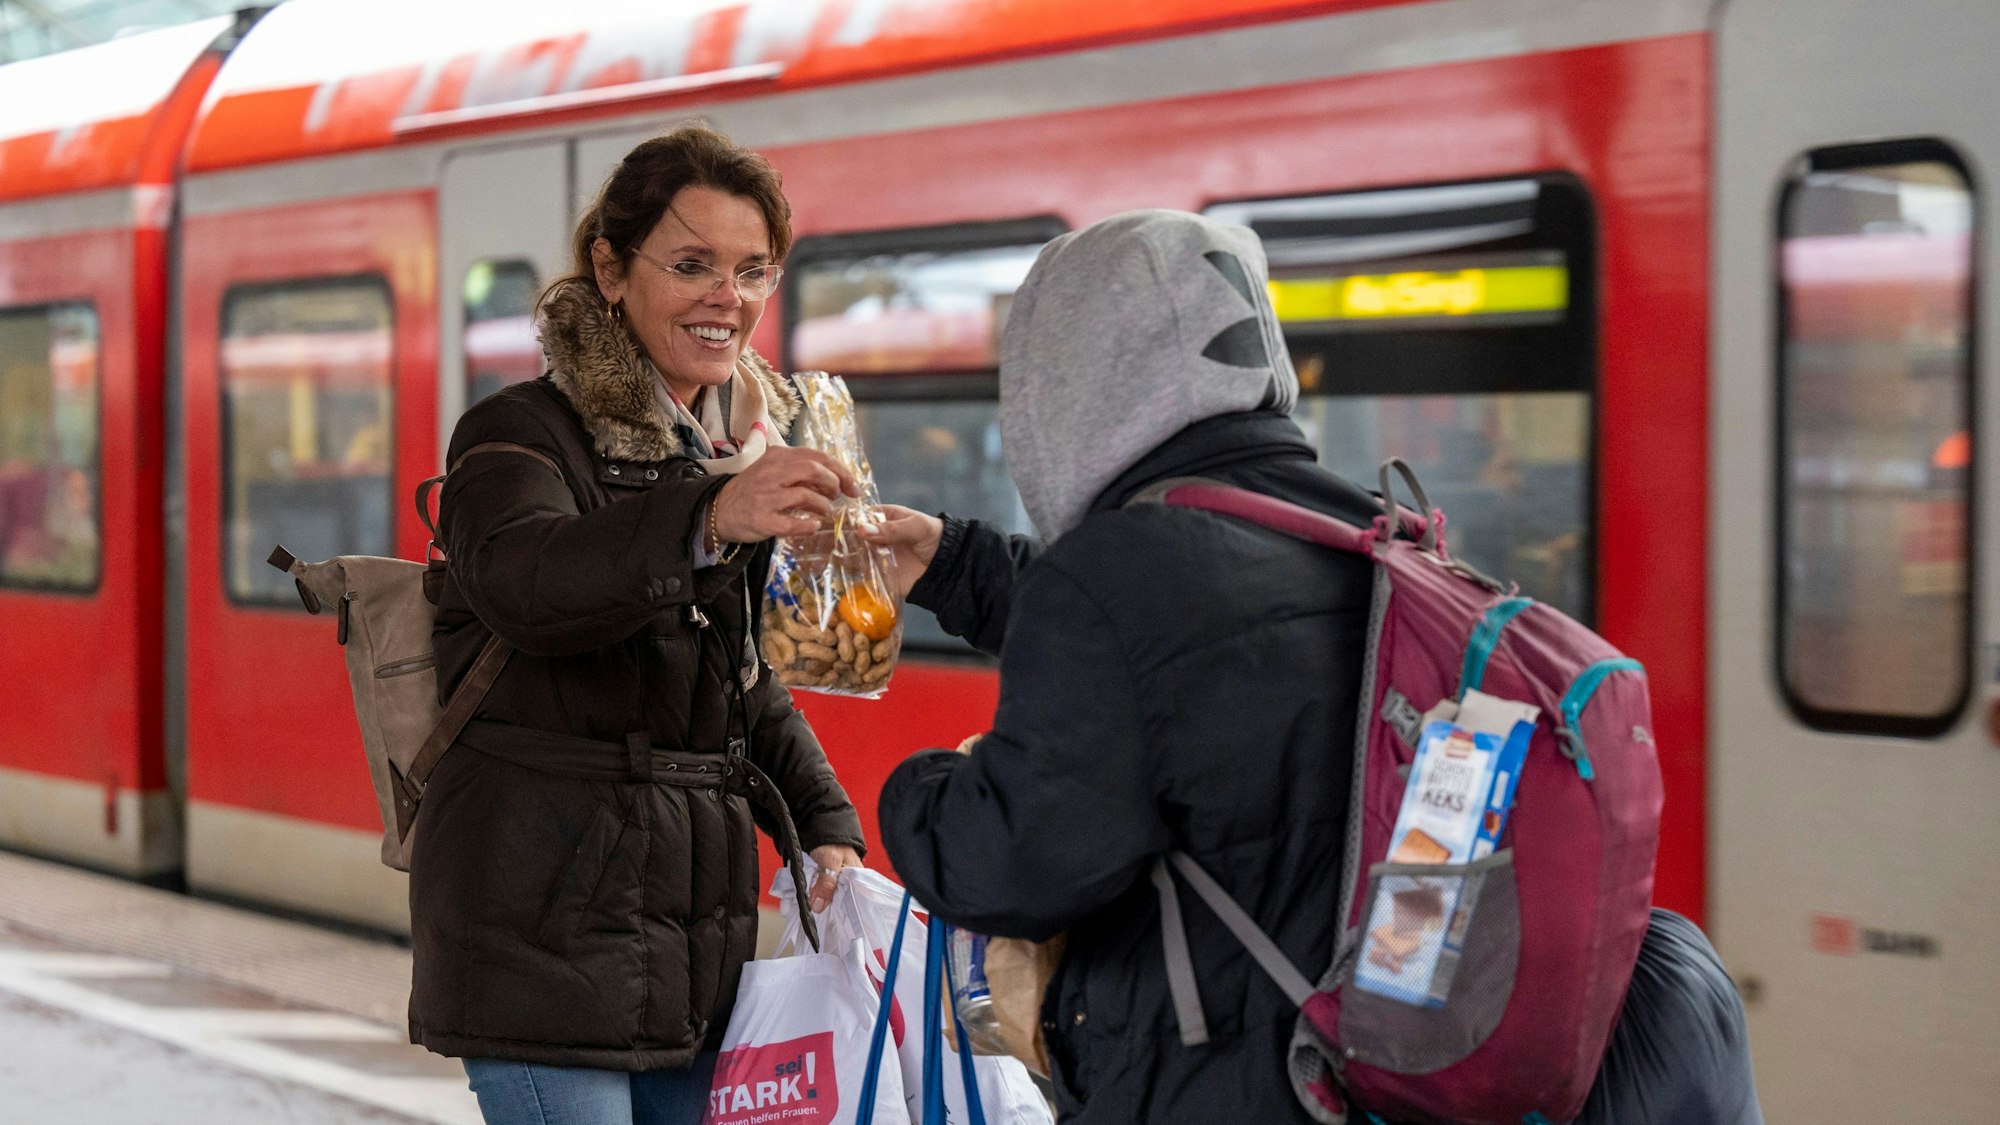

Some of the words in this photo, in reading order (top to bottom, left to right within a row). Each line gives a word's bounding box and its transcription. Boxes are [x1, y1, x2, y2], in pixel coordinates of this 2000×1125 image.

[1422, 789, 1465, 812] KEKS
[775, 1055, 802, 1076] sei
[710, 1051, 817, 1118] STARK!
[750, 1112, 780, 1124] helfen
[782, 1106, 820, 1118] Frauen.
